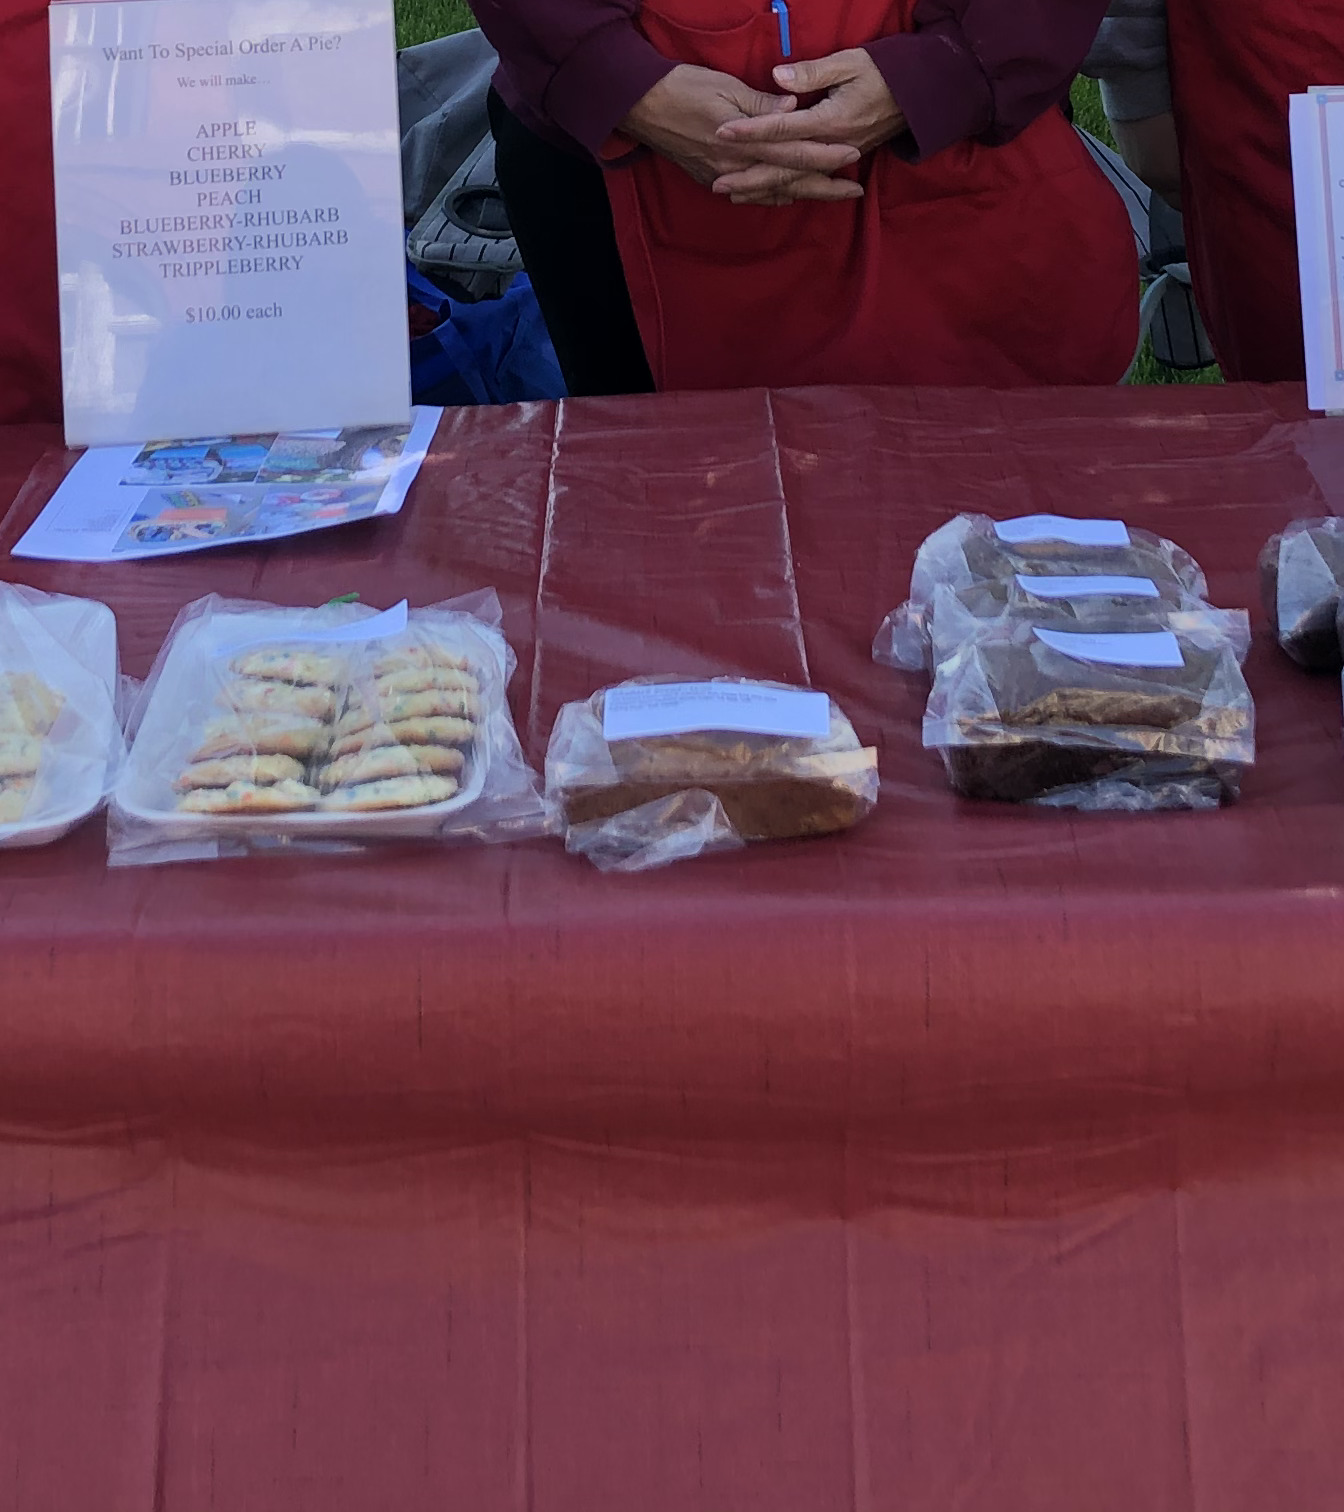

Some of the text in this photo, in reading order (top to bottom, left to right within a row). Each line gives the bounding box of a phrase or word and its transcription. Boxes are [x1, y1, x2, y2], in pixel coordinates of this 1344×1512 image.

[102, 36, 342, 61] Want To Special Order A Pie?
[177, 77, 195, 88] We
[199, 76, 221, 87] will
[196, 121, 256, 139] APPLE
[187, 143, 267, 162] CHERRY
[169, 164, 286, 186] BLUEBERRY
[197, 189, 262, 207] PEACH
[120, 207, 340, 235] BLUEBERRY-RHUBARB
[112, 229, 349, 258] STRAWBERRY-RHUBARB
[159, 255, 304, 278] TRIPPLEBERRY
[186, 303, 282, 324] $10.00 each
